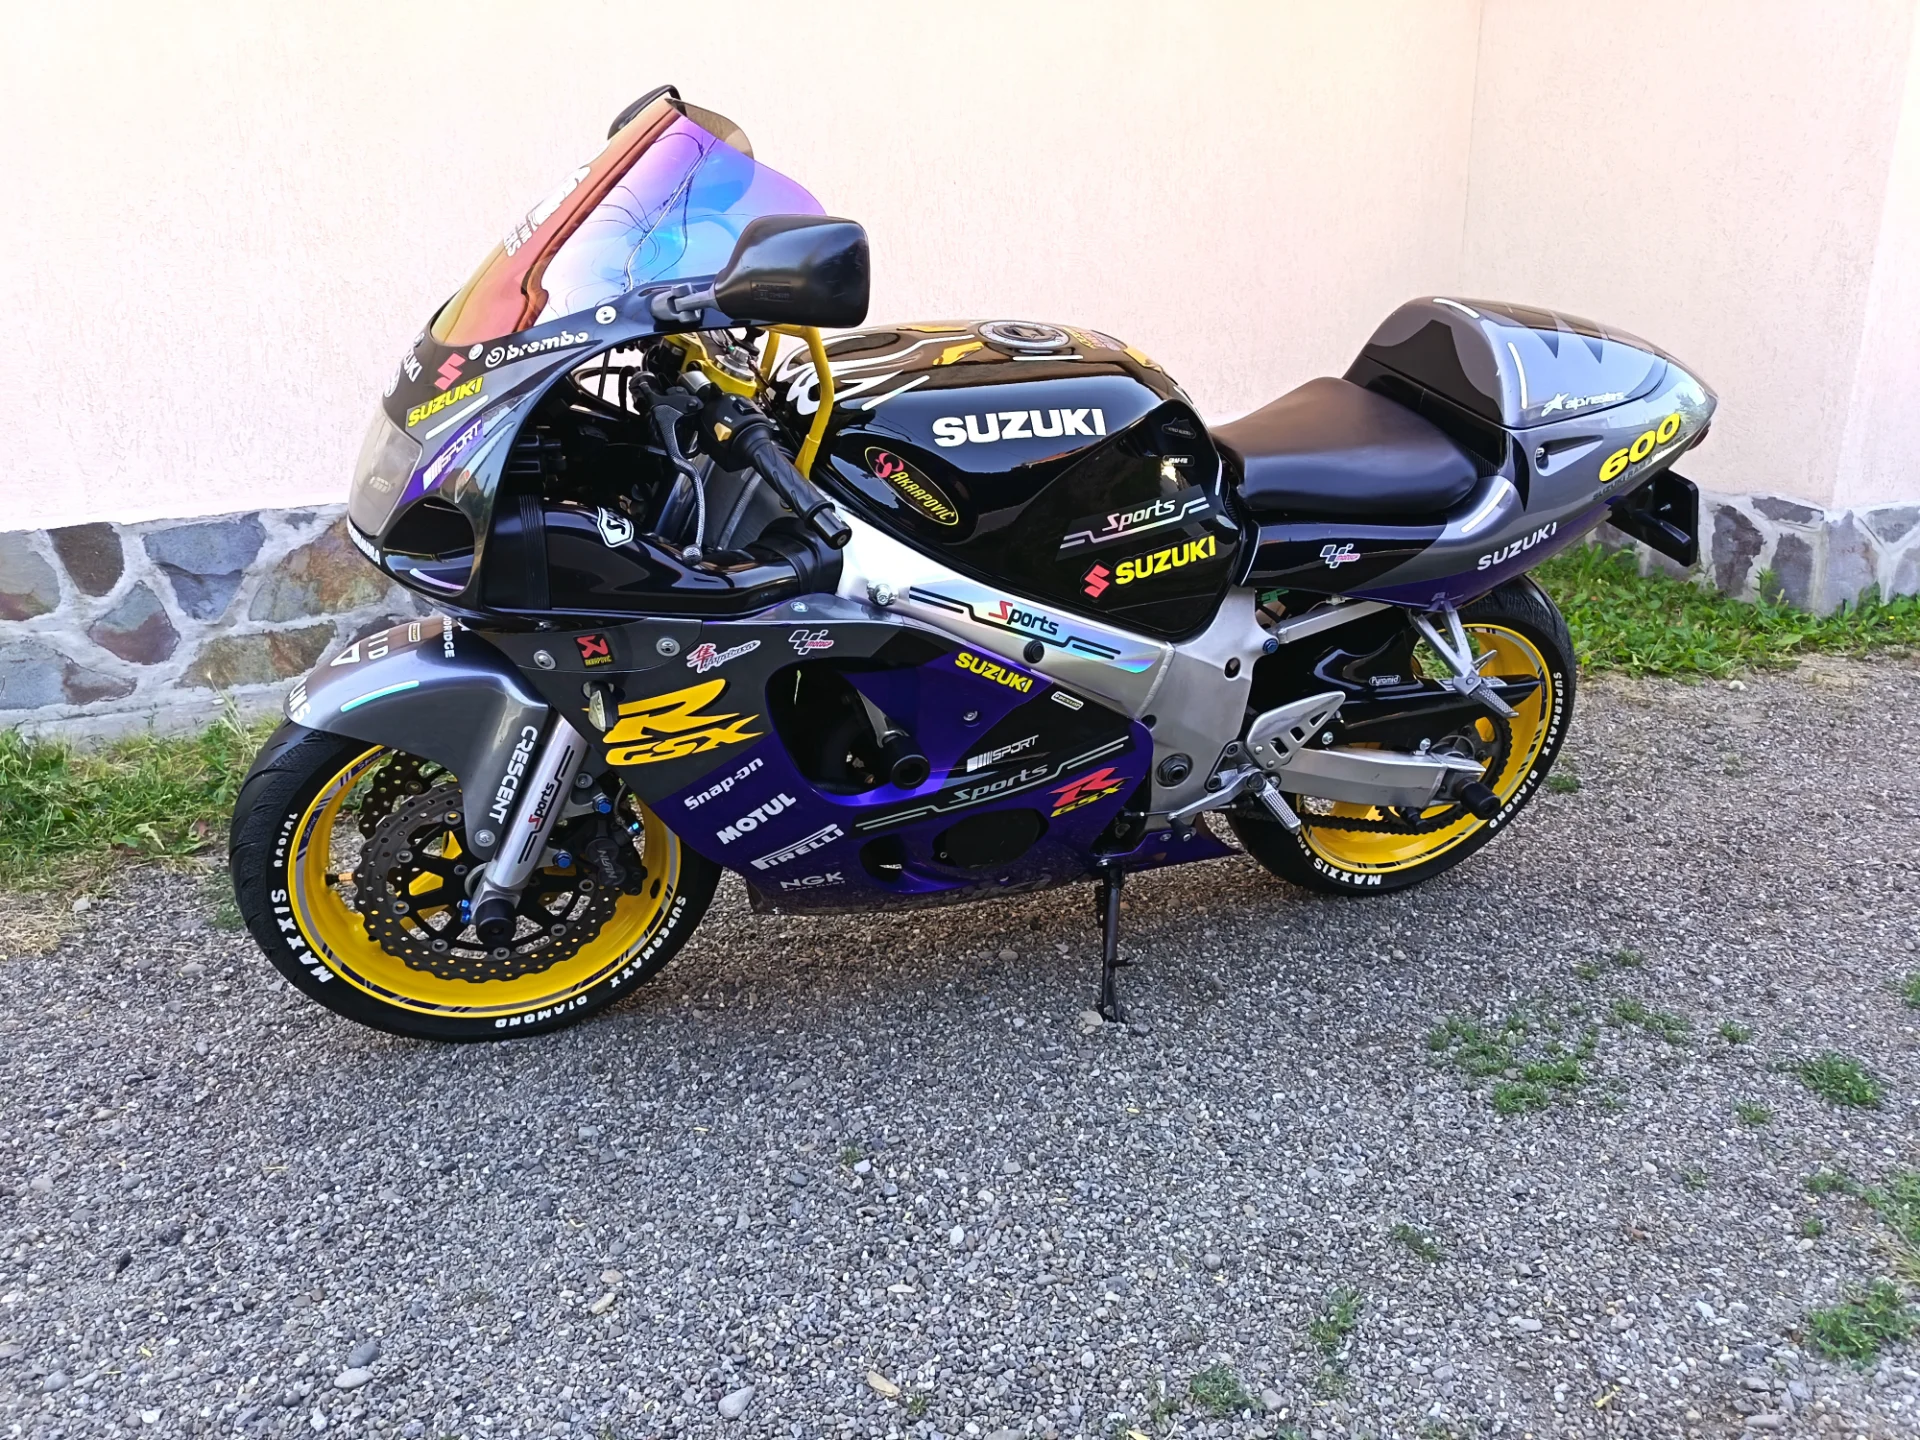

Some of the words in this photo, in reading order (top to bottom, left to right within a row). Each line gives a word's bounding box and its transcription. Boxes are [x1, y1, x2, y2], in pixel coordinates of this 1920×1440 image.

[506, 331, 589, 361] brembo
[407, 376, 484, 428] SUZUKI
[931, 408, 1107, 447] SUZUKI
[1598, 413, 1681, 482] 600
[1102, 499, 1176, 532] Sports
[1115, 535, 1216, 585] SUZUKI
[1477, 522, 1557, 571] SUZUKI
[988, 600, 1059, 636] Sports
[955, 652, 1034, 693] SUZUKI
[1371, 675, 1400, 686] Pyramid
[489, 725, 538, 825] CRESCENT
[684, 757, 764, 810] Snap-on
[954, 764, 1049, 801] Sports
[528, 781, 555, 829] Sports
[716, 793, 797, 845] MOTUL
[1489, 770, 1538, 829] DIAMOND
[273, 812, 298, 868] RADIAL
[750, 823, 844, 870] PIRELLI
[780, 871, 844, 889] NGK
[1313, 857, 1382, 885] MAXXIS
[271, 889, 334, 983] MAXXIS
[611, 895, 687, 988] SUPERMAXX
[495, 995, 587, 1028] DIAMOND
